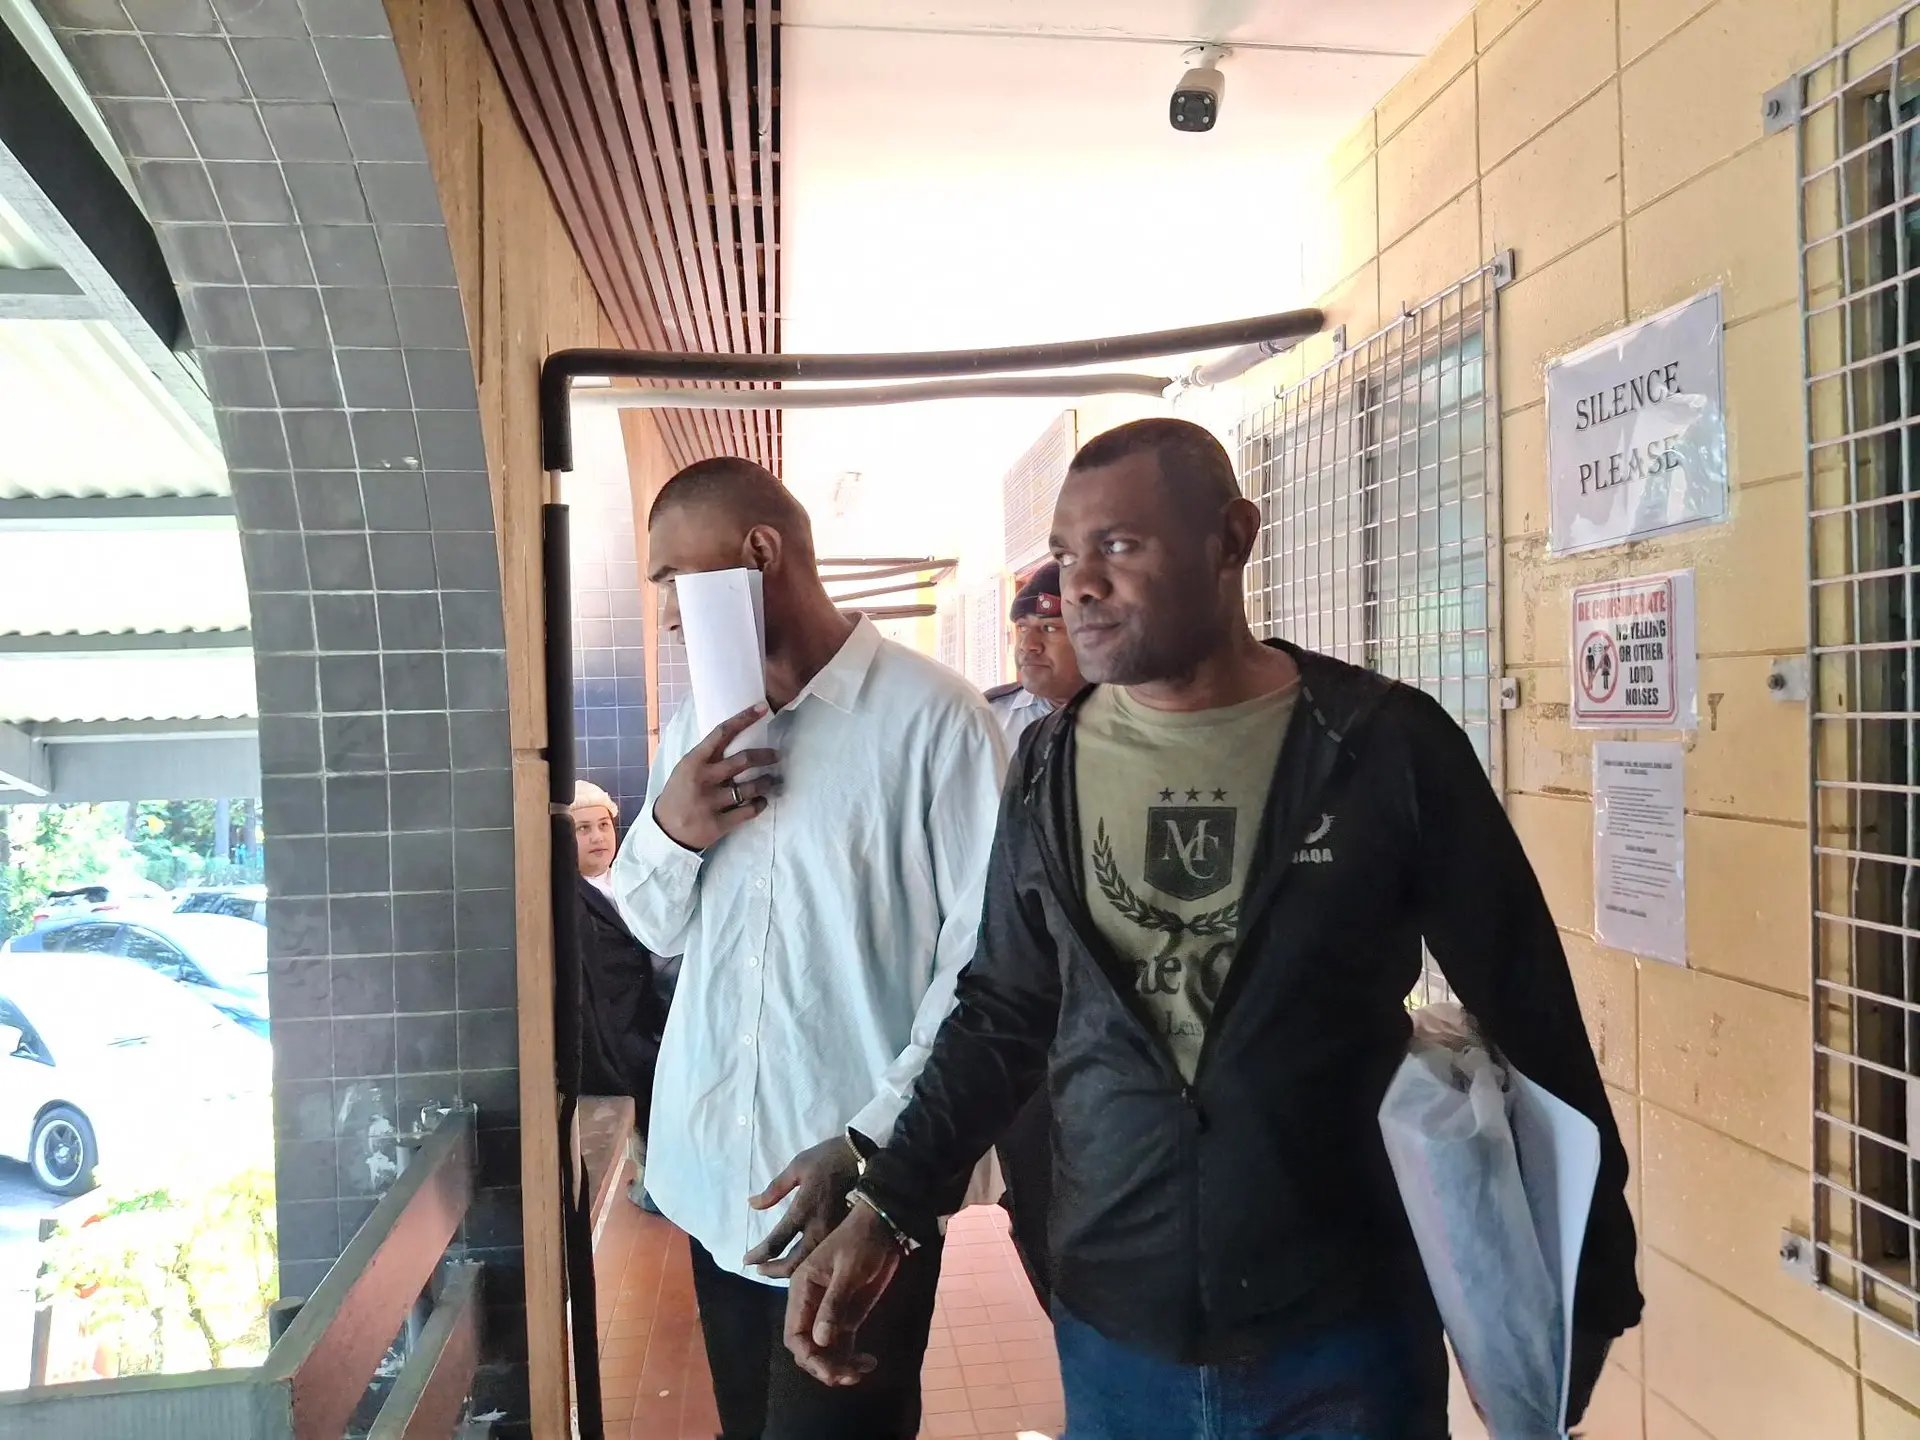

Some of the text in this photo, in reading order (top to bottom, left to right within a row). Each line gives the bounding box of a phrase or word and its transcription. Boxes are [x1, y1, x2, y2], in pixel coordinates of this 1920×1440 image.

[1575, 361, 1681, 430] SILENCE
[1578, 434, 1680, 495] PLEASE
[1578, 601, 1590, 622] BE
[1616, 620, 1666, 641] NO YELLING
[1618, 642, 1663, 662] OR OTHER
[1629, 665, 1653, 684] LOUD
[1625, 687, 1659, 705] NOISES
[1161, 819, 1219, 880] MC
